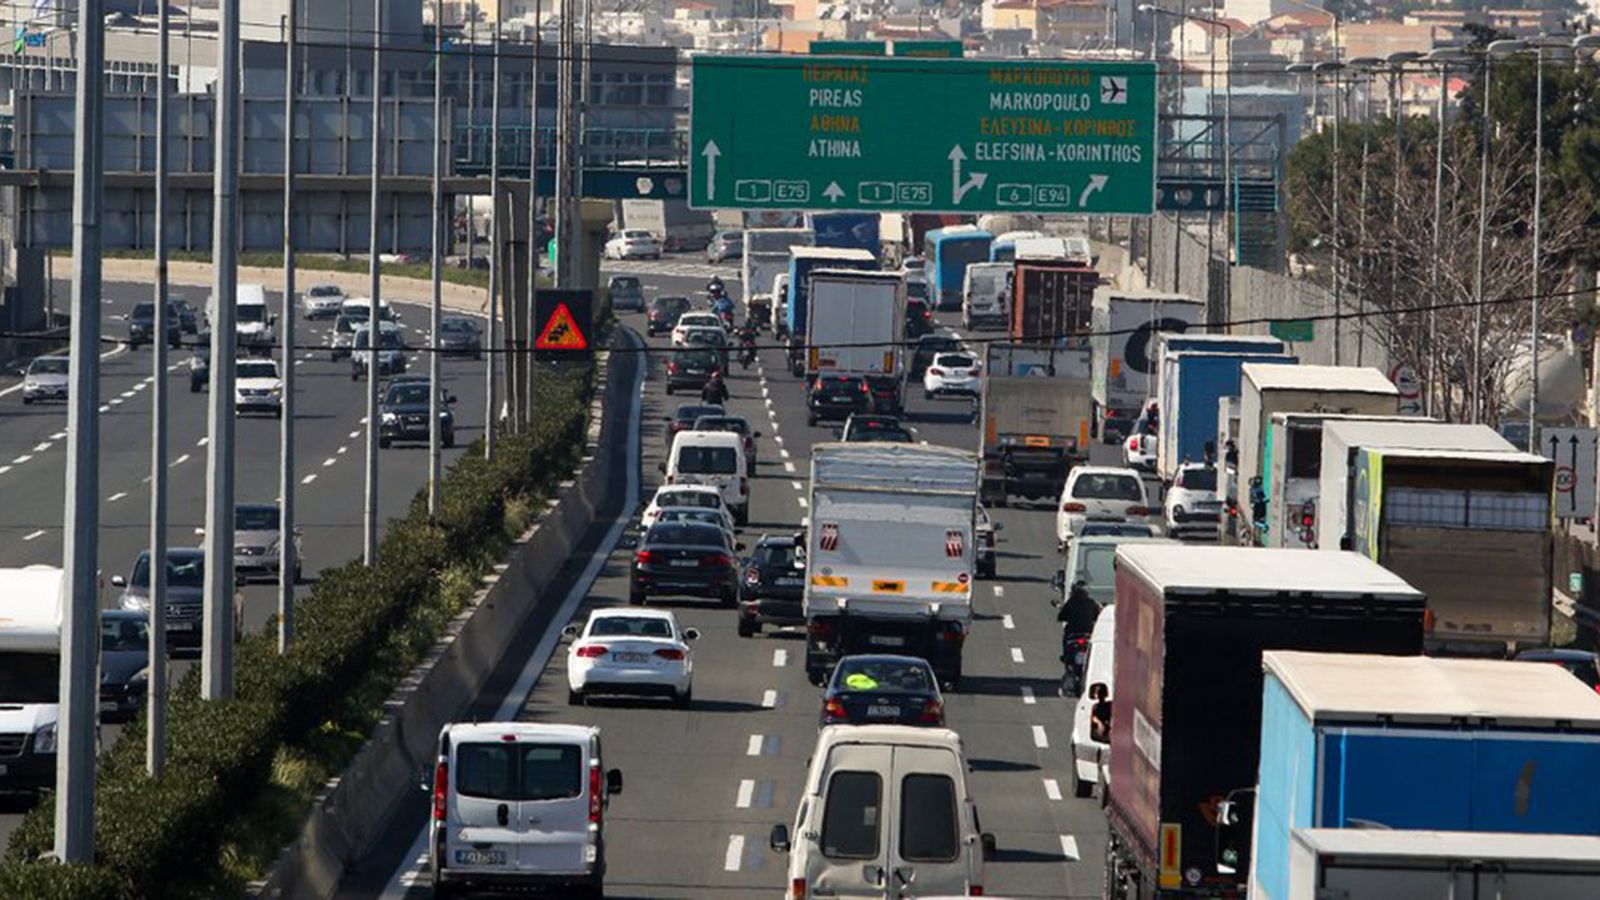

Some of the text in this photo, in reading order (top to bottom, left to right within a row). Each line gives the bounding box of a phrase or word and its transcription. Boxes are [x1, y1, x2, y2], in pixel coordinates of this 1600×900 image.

[809, 88, 862, 107] PIREAS
[989, 92, 1091, 111] MARKOPOULO
[811, 114, 859, 133] ΑΘΗΝΑ
[808, 139, 862, 157] ATHINA
[777, 185, 805, 198] E75
[901, 186, 927, 200] E75
[1010, 188, 1019, 201] 6
[1038, 188, 1065, 202] E94
